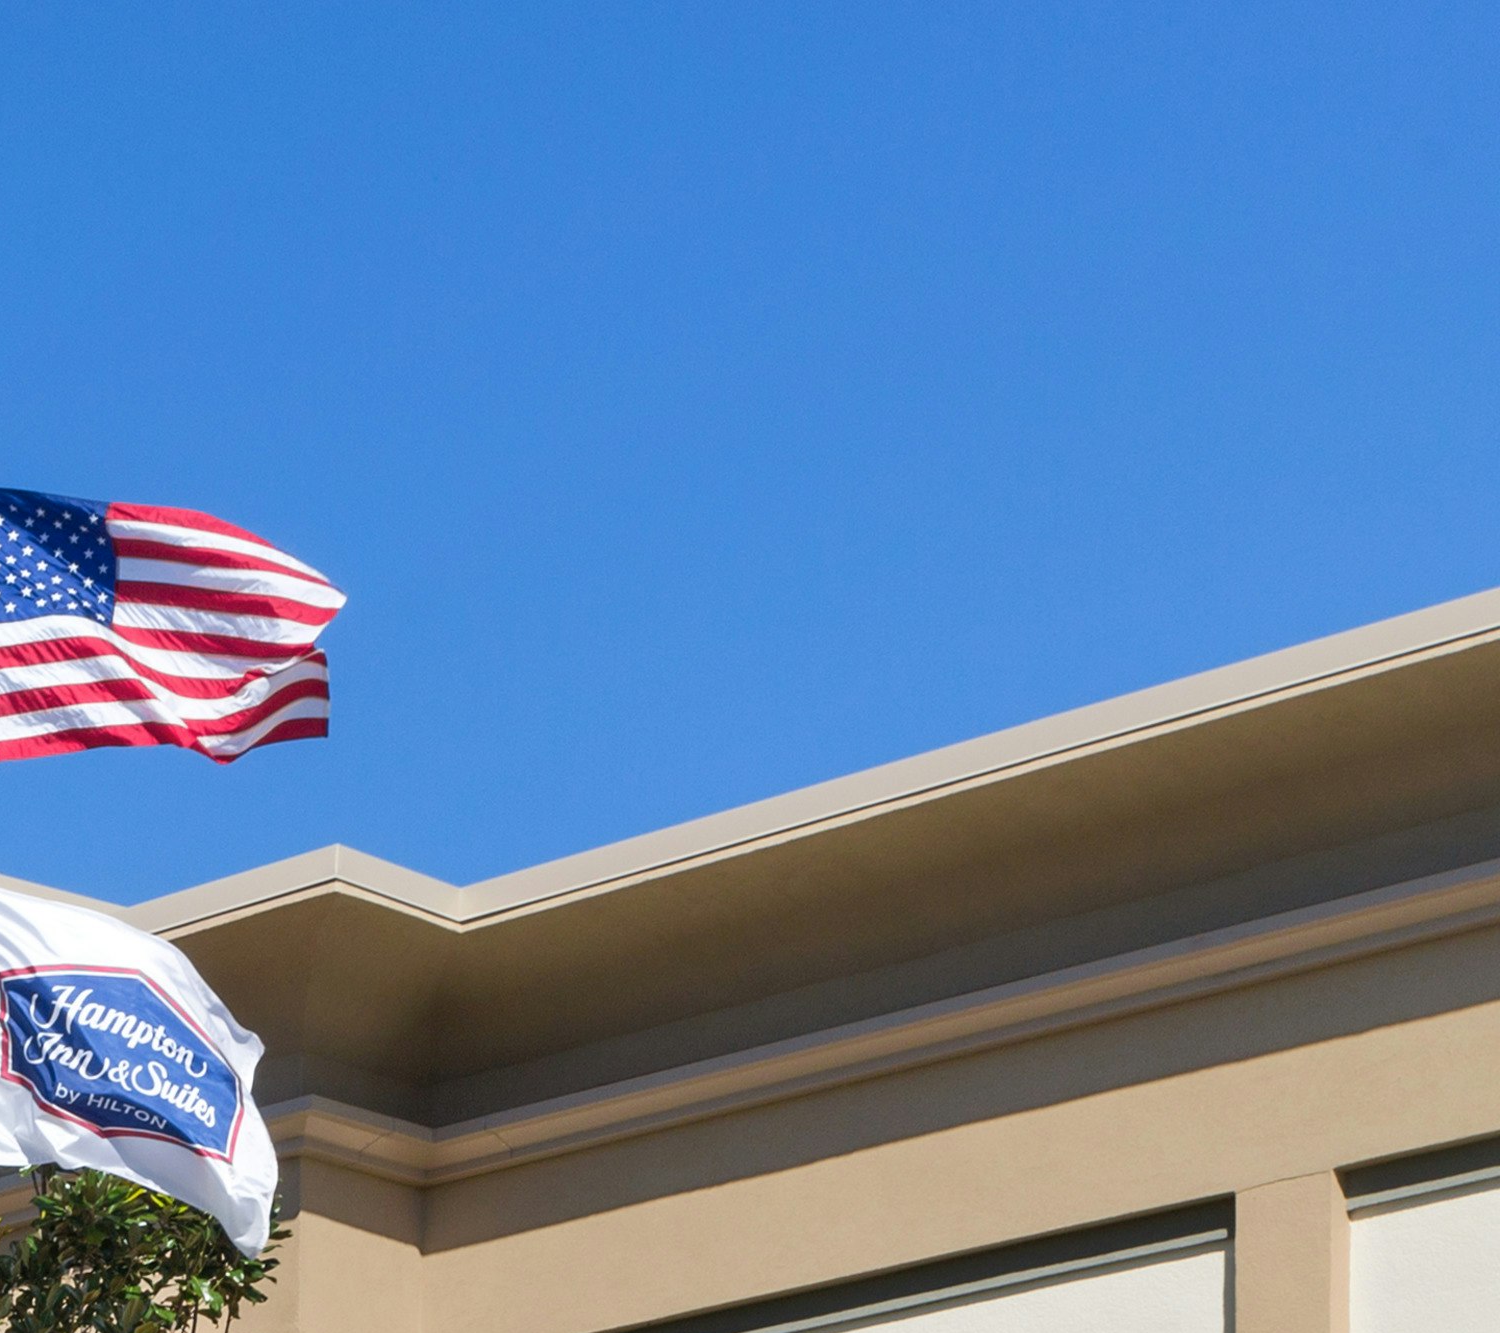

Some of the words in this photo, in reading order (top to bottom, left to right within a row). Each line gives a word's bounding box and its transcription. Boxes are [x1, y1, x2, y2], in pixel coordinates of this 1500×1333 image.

[29, 985, 208, 1078] Hampton
[23, 1031, 110, 1080] Inn
[108, 1059, 131, 1091] &
[131, 1060, 217, 1128] Suites
[55, 1082, 80, 1105] by
[87, 1094, 168, 1130] HILTON
